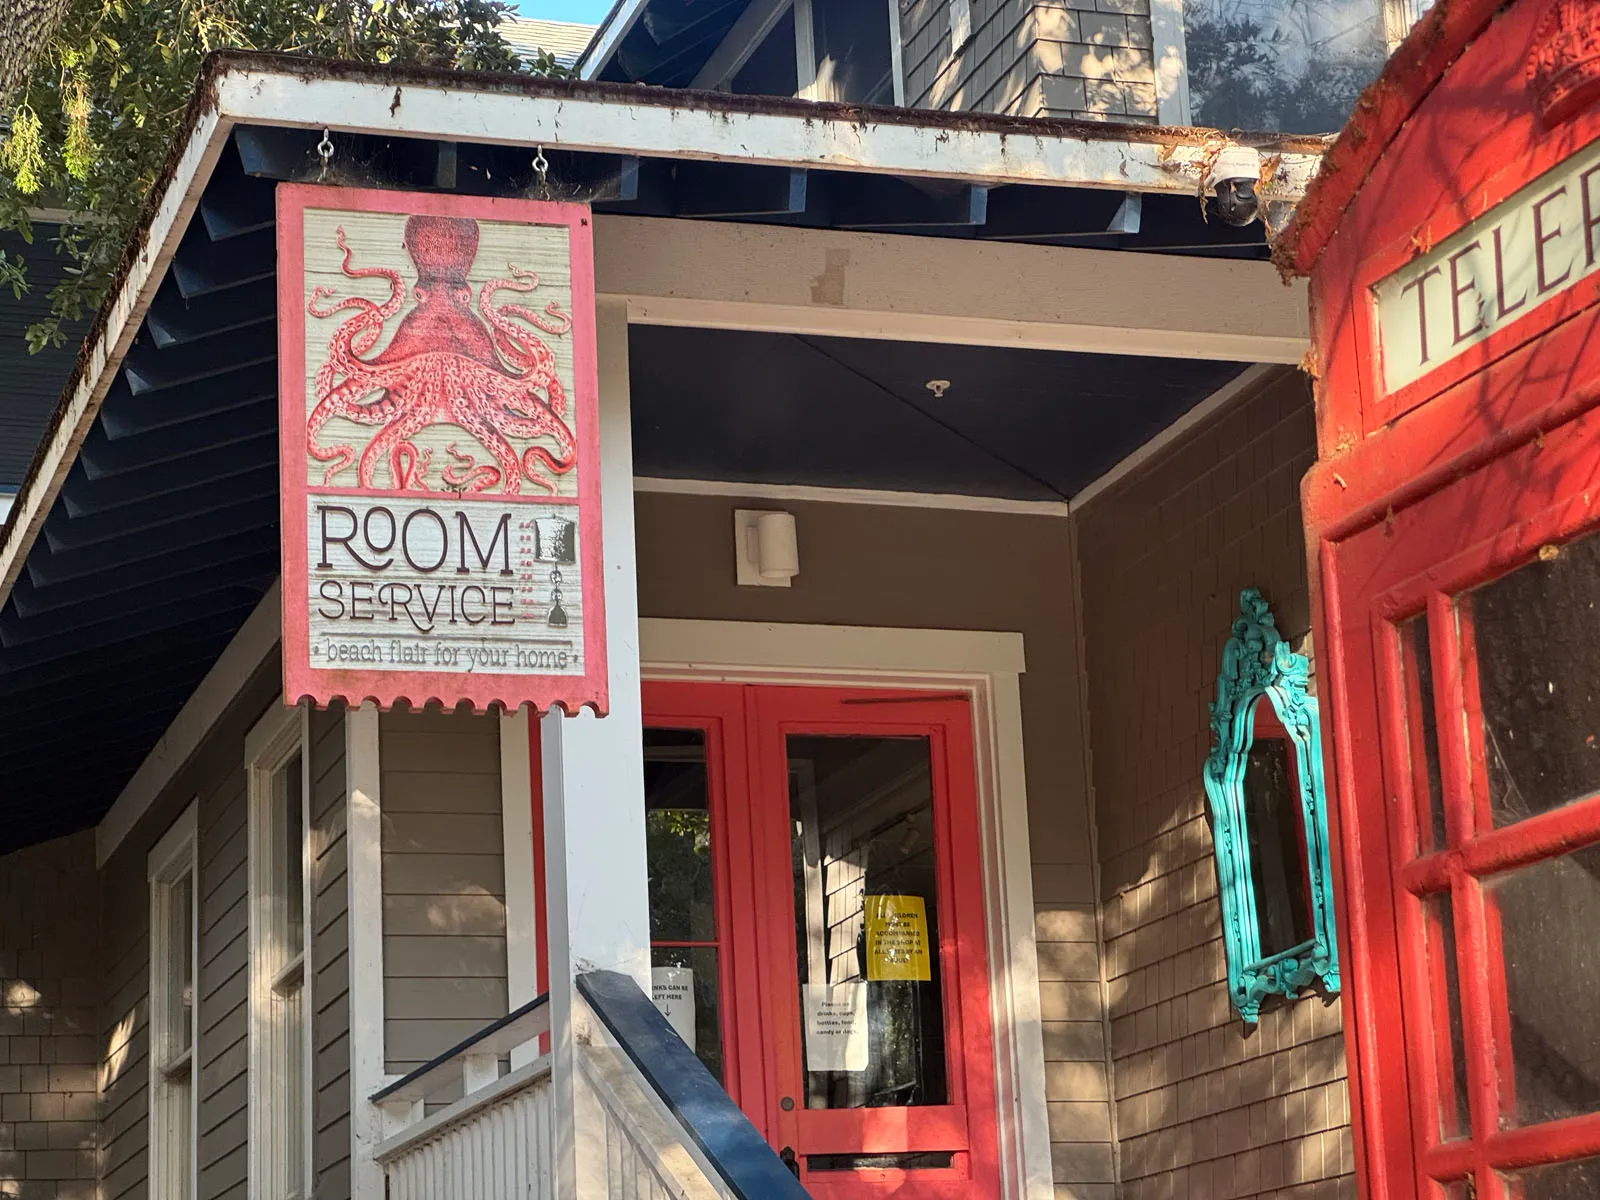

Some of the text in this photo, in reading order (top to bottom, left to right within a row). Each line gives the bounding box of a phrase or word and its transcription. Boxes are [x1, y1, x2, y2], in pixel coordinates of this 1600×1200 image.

[314, 505, 514, 576] ROOM
[318, 580, 516, 633] SERVICE
[325, 637, 568, 673] beach flair for your home
